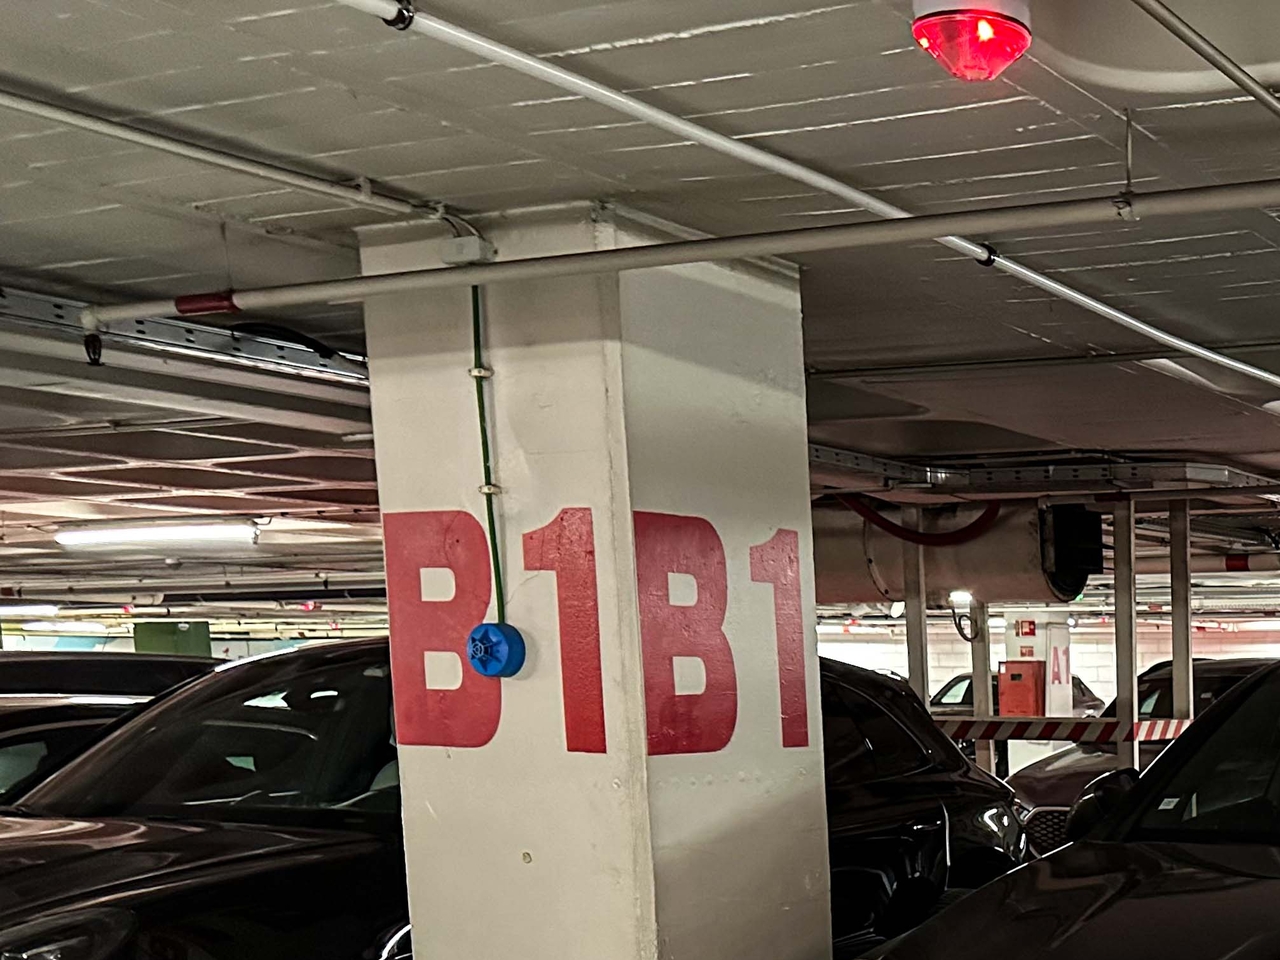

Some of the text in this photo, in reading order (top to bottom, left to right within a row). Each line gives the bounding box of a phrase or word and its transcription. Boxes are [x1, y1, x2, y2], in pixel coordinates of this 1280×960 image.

[383, 507, 607, 753] B1
[633, 510, 808, 756] B1
[1051, 646, 1070, 684] A1
